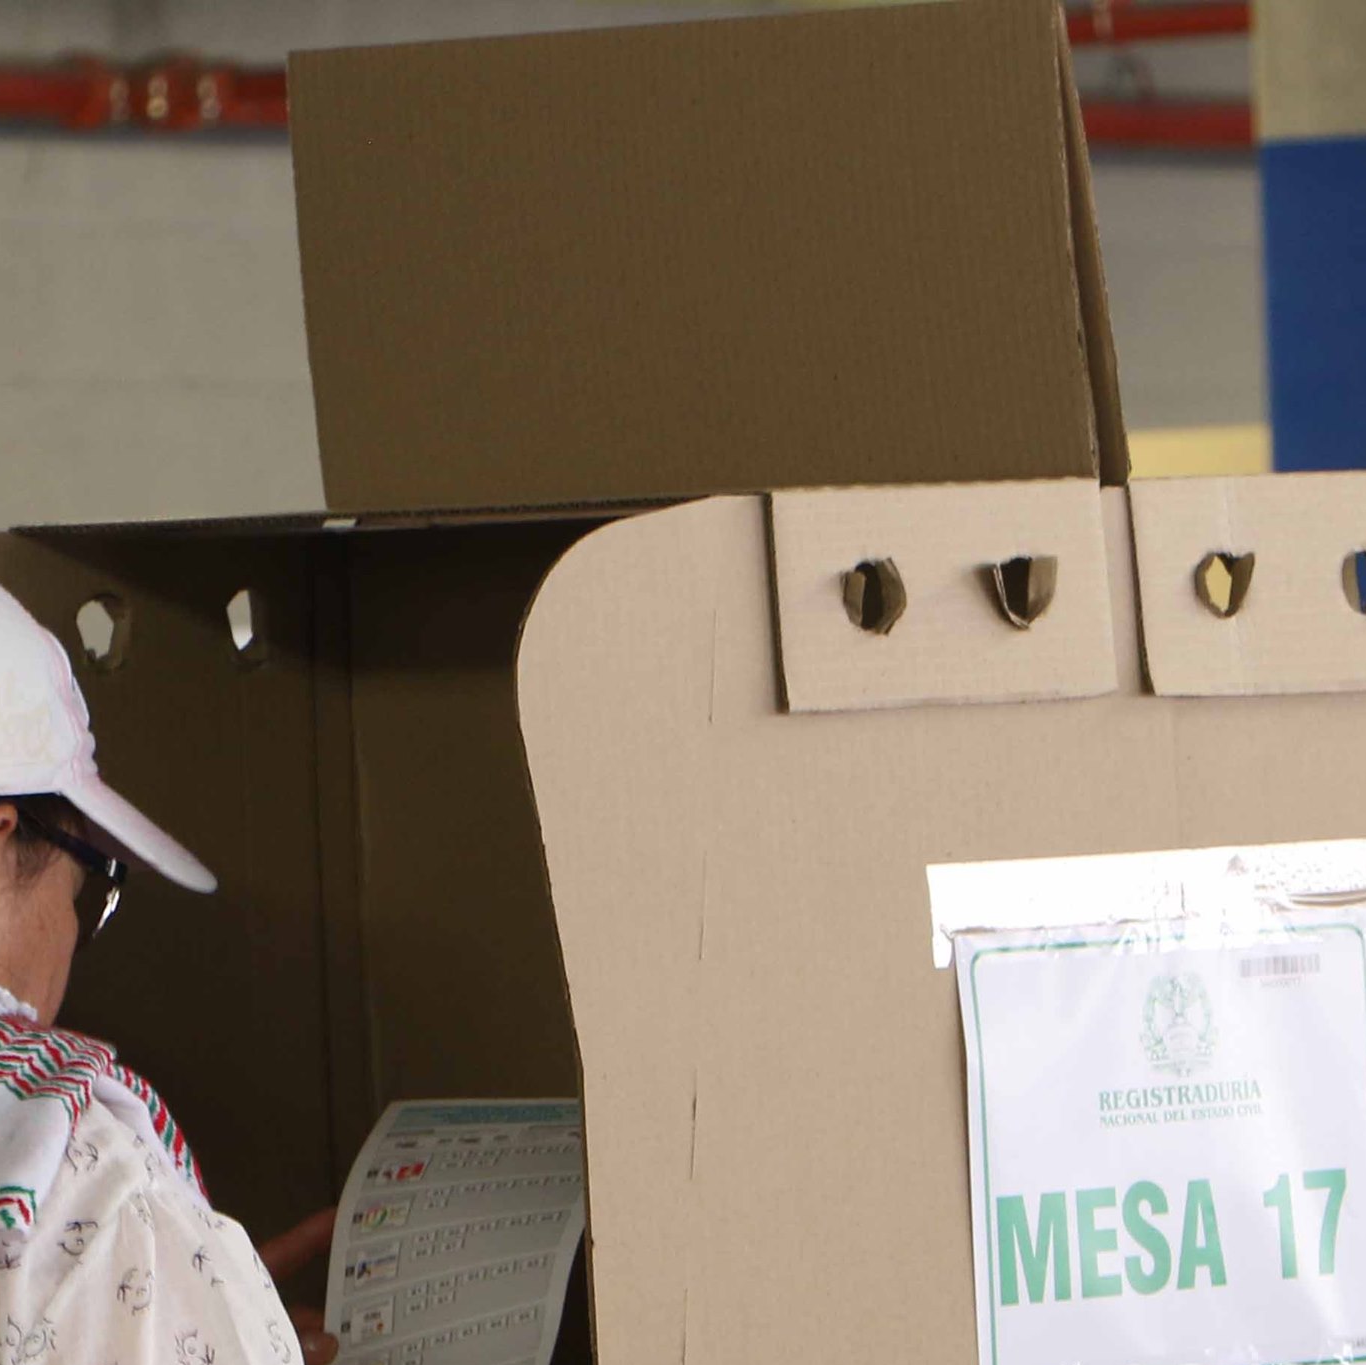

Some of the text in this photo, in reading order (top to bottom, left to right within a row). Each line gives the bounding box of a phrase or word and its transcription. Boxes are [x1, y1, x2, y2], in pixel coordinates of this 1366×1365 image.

[1098, 1074, 1263, 1111] REGISTRADURÍA
[1099, 1103, 1264, 1127] NACIONAL DEL ESTADO CIVIL
[996, 1168, 1348, 1307] MESA 17
